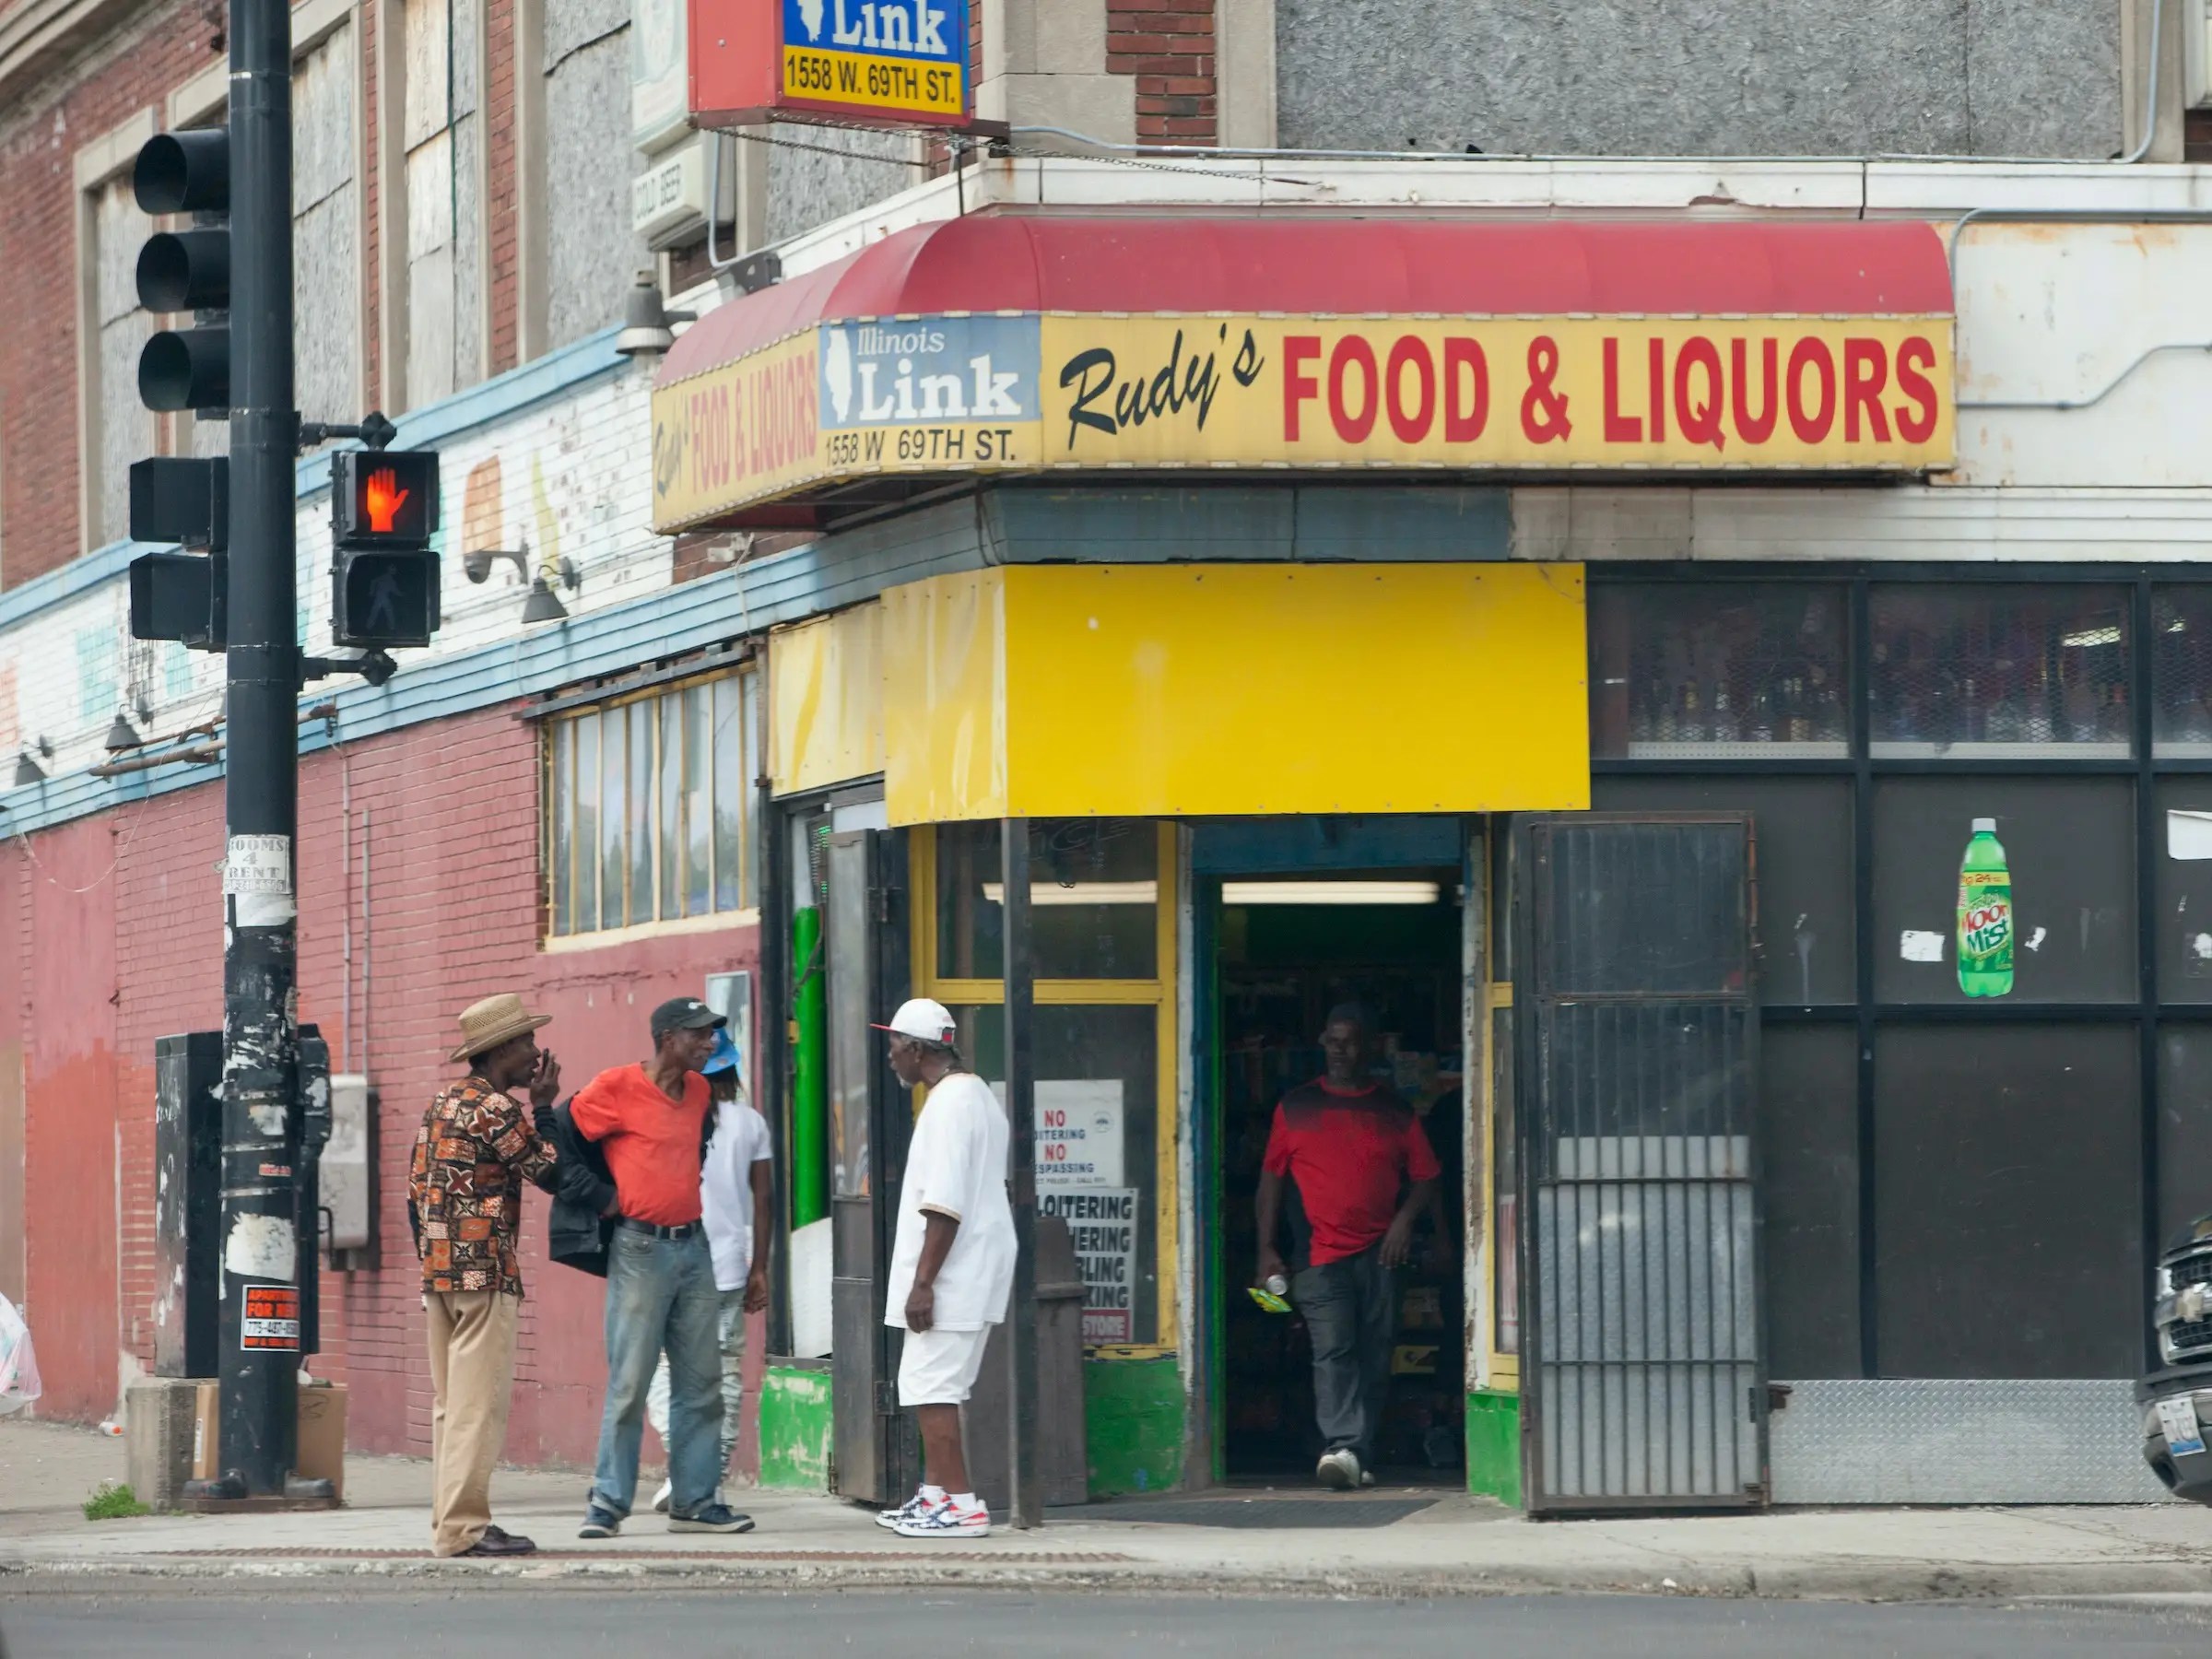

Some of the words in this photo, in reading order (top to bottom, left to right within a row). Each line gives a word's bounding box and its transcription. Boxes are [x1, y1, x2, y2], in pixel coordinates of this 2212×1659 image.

[832, 0, 948, 55] Link
[787, 54, 831, 90] 1558
[837, 60, 863, 94] W.
[868, 64, 919, 100] 69TH
[926, 69, 956, 104] ST.
[857, 326, 945, 356] Illinois
[858, 354, 1022, 421] Link
[1060, 322, 1265, 451] Rudy's
[1283, 334, 1490, 444] FOOD
[1520, 335, 1572, 445] &
[1602, 335, 1939, 453] LIQUORS
[692, 383, 730, 495] FOOD
[749, 349, 818, 478] LIQUORS
[826, 433, 859, 467] 1558
[865, 430, 886, 462] W
[898, 429, 965, 460] 69TH
[975, 429, 1017, 461] ST.
[229, 866, 280, 878] RENT
[243, 852, 259, 865] 4
[1044, 1110, 1065, 1127] NO
[1035, 1129, 1086, 1141] OITERING
[1044, 1144, 1066, 1161] NO
[247, 1302, 273, 1318] FOR
